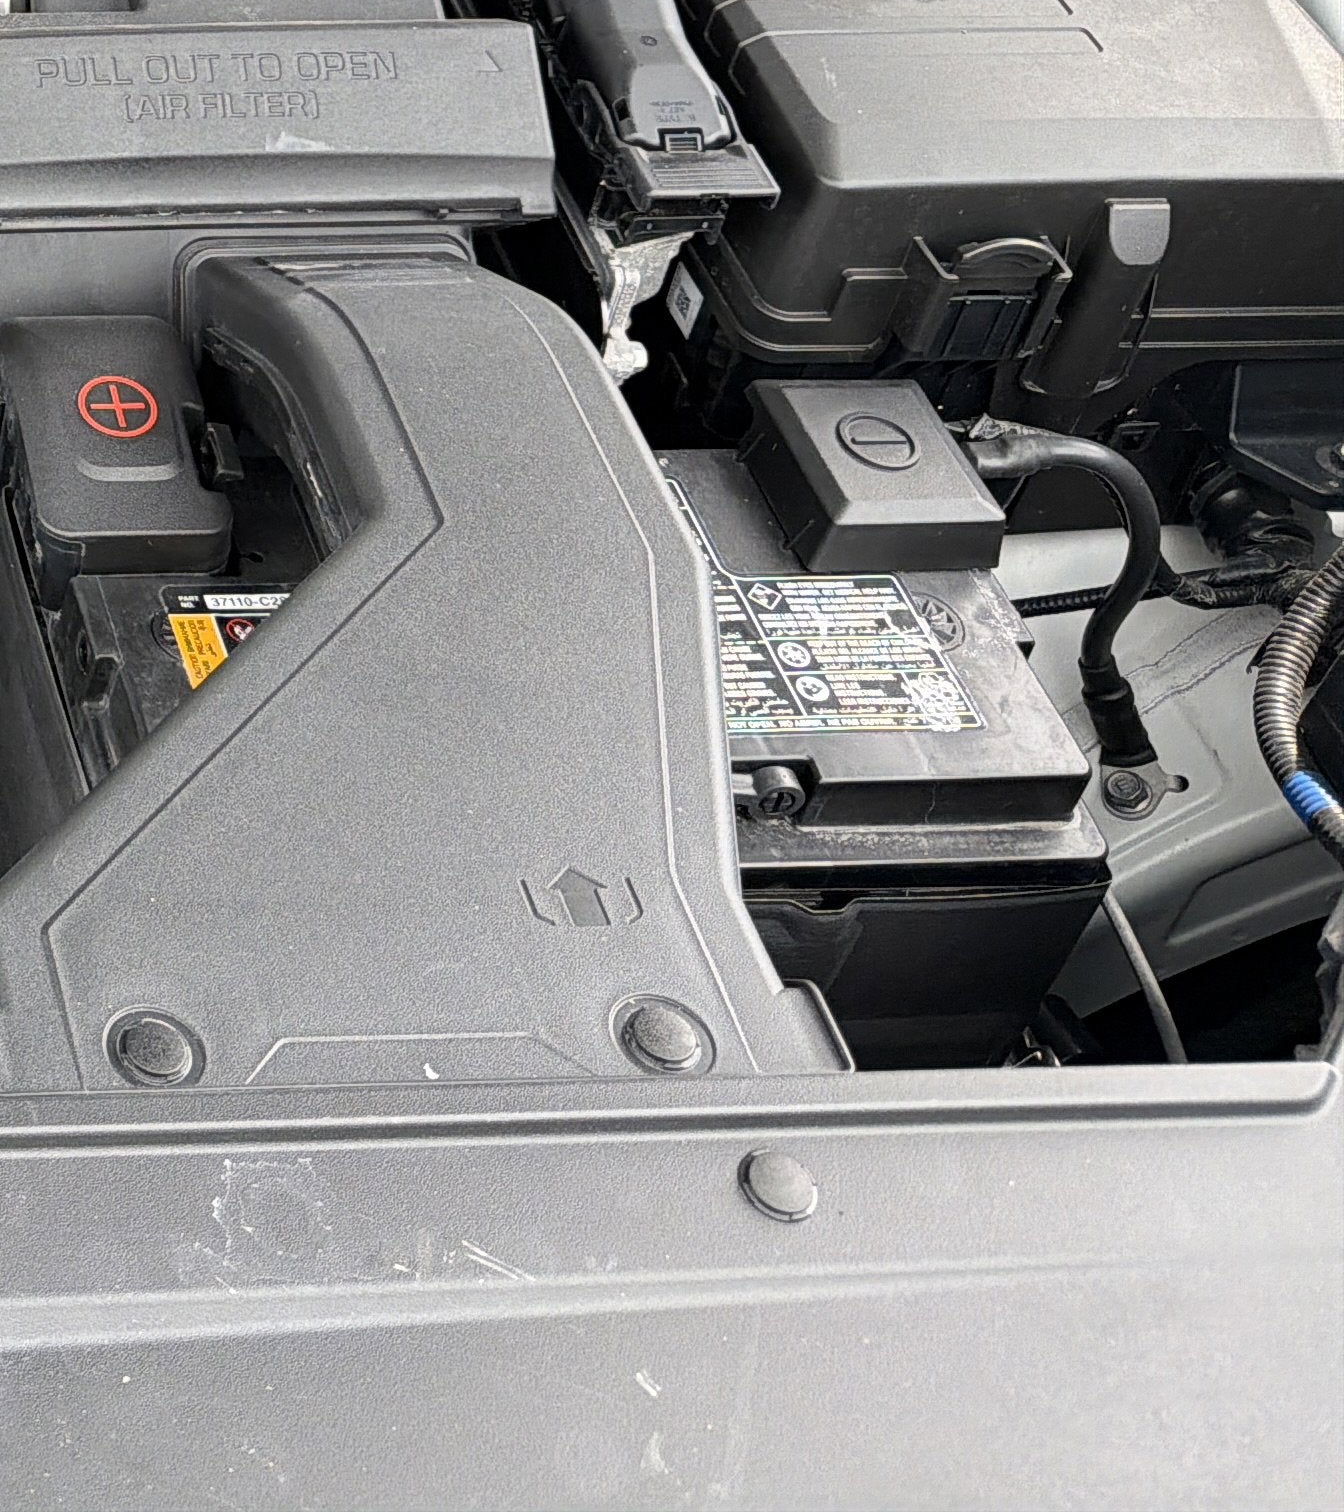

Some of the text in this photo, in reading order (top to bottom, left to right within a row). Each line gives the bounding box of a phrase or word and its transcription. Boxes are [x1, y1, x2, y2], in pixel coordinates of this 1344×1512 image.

[34, 50, 398, 88] PULL OUT TO OPEN
[122, 89, 320, 123] (AIR FILTER)
